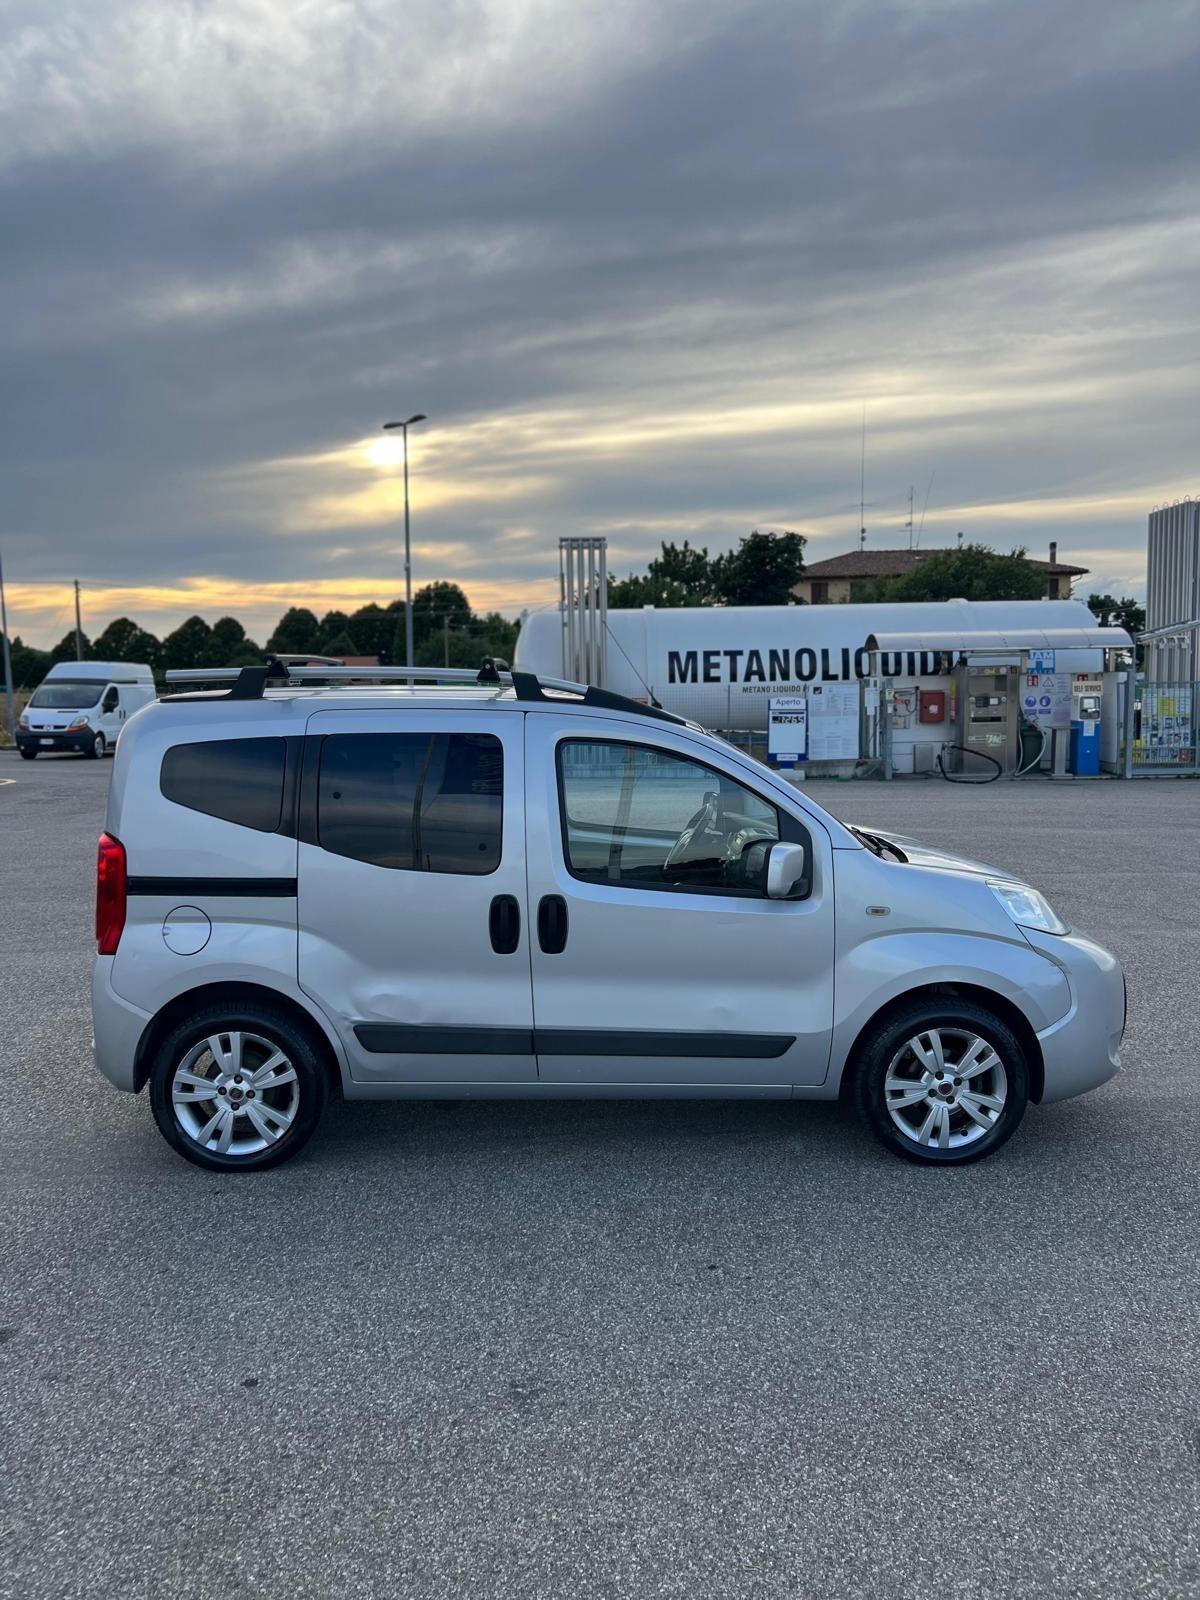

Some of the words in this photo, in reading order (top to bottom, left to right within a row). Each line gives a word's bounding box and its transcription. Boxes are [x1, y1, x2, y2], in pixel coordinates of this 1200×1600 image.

[742, 685, 772, 694] METANO
[773, 684, 802, 694] LIQUIDO
[775, 698, 801, 708] Aperto
